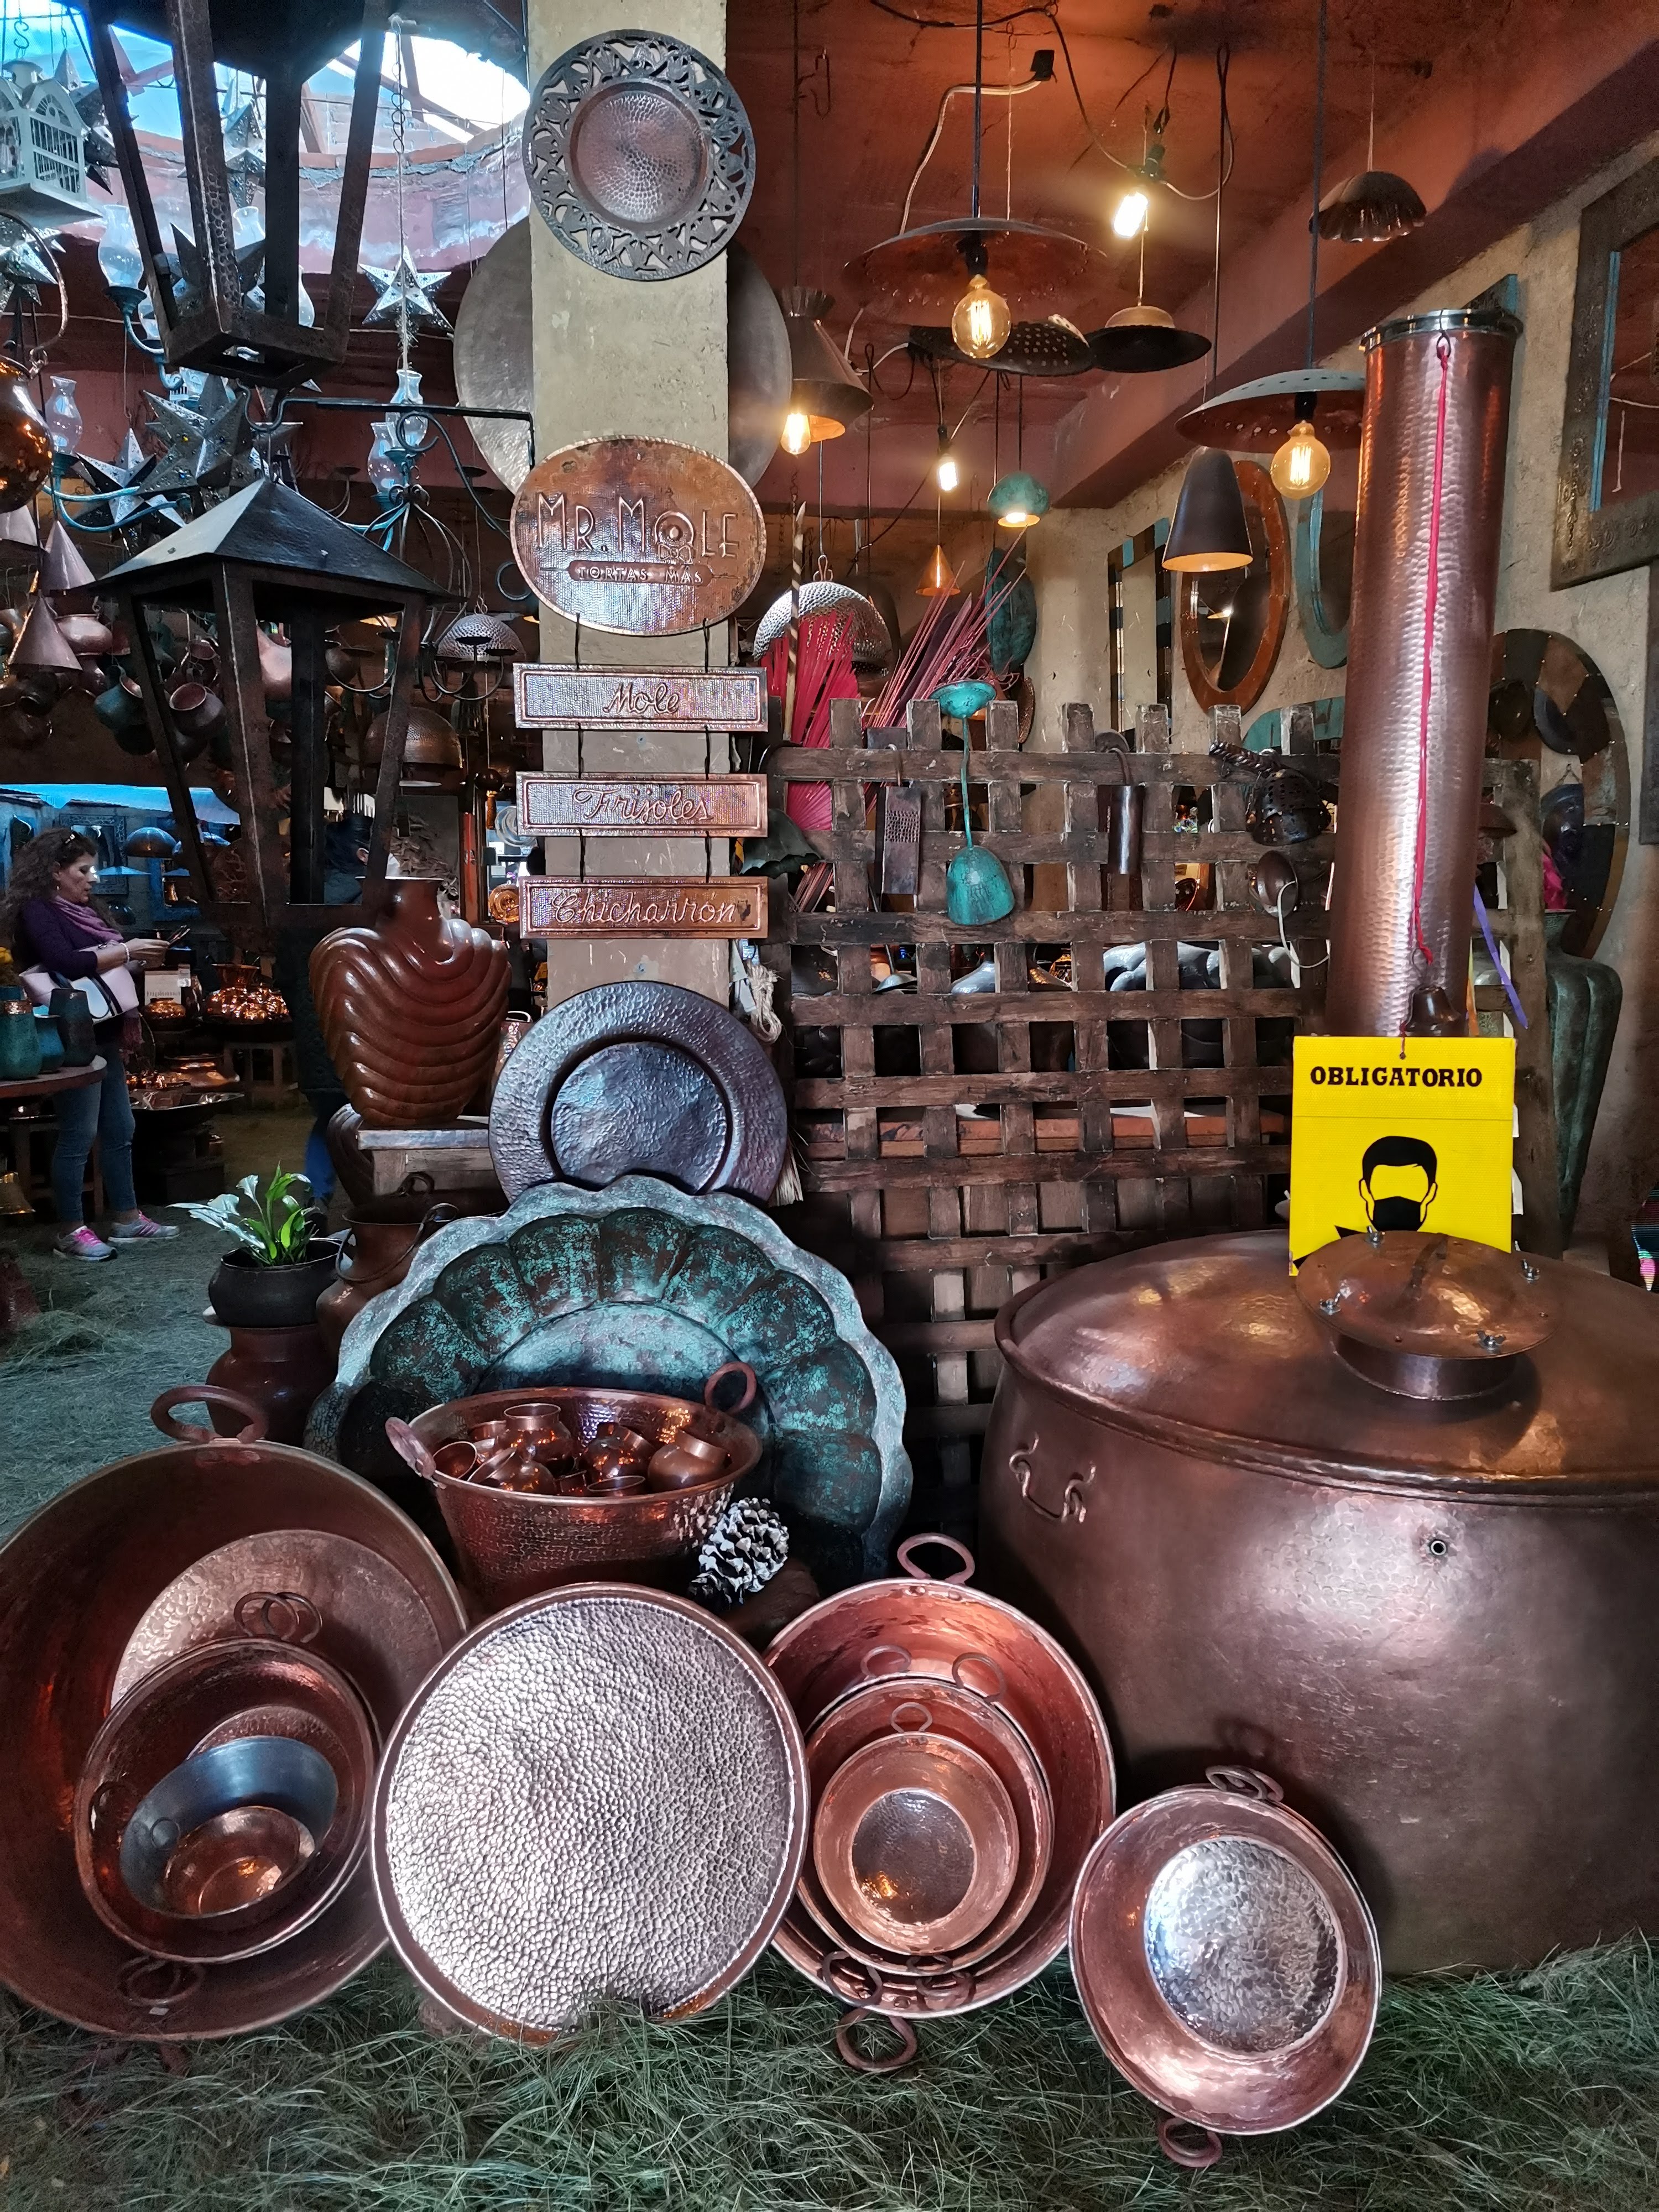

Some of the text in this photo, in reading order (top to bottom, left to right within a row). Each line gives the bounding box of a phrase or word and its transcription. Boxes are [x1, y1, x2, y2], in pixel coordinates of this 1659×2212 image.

[538, 493, 740, 560] MR. MOLE
[577, 566, 648, 582] TORTAS
[603, 682, 680, 714] Mole
[573, 787, 714, 823] Frijoles
[551, 888, 737, 925] Chicharrón
[1310, 1066, 1483, 1087] OBLIGATORIO
